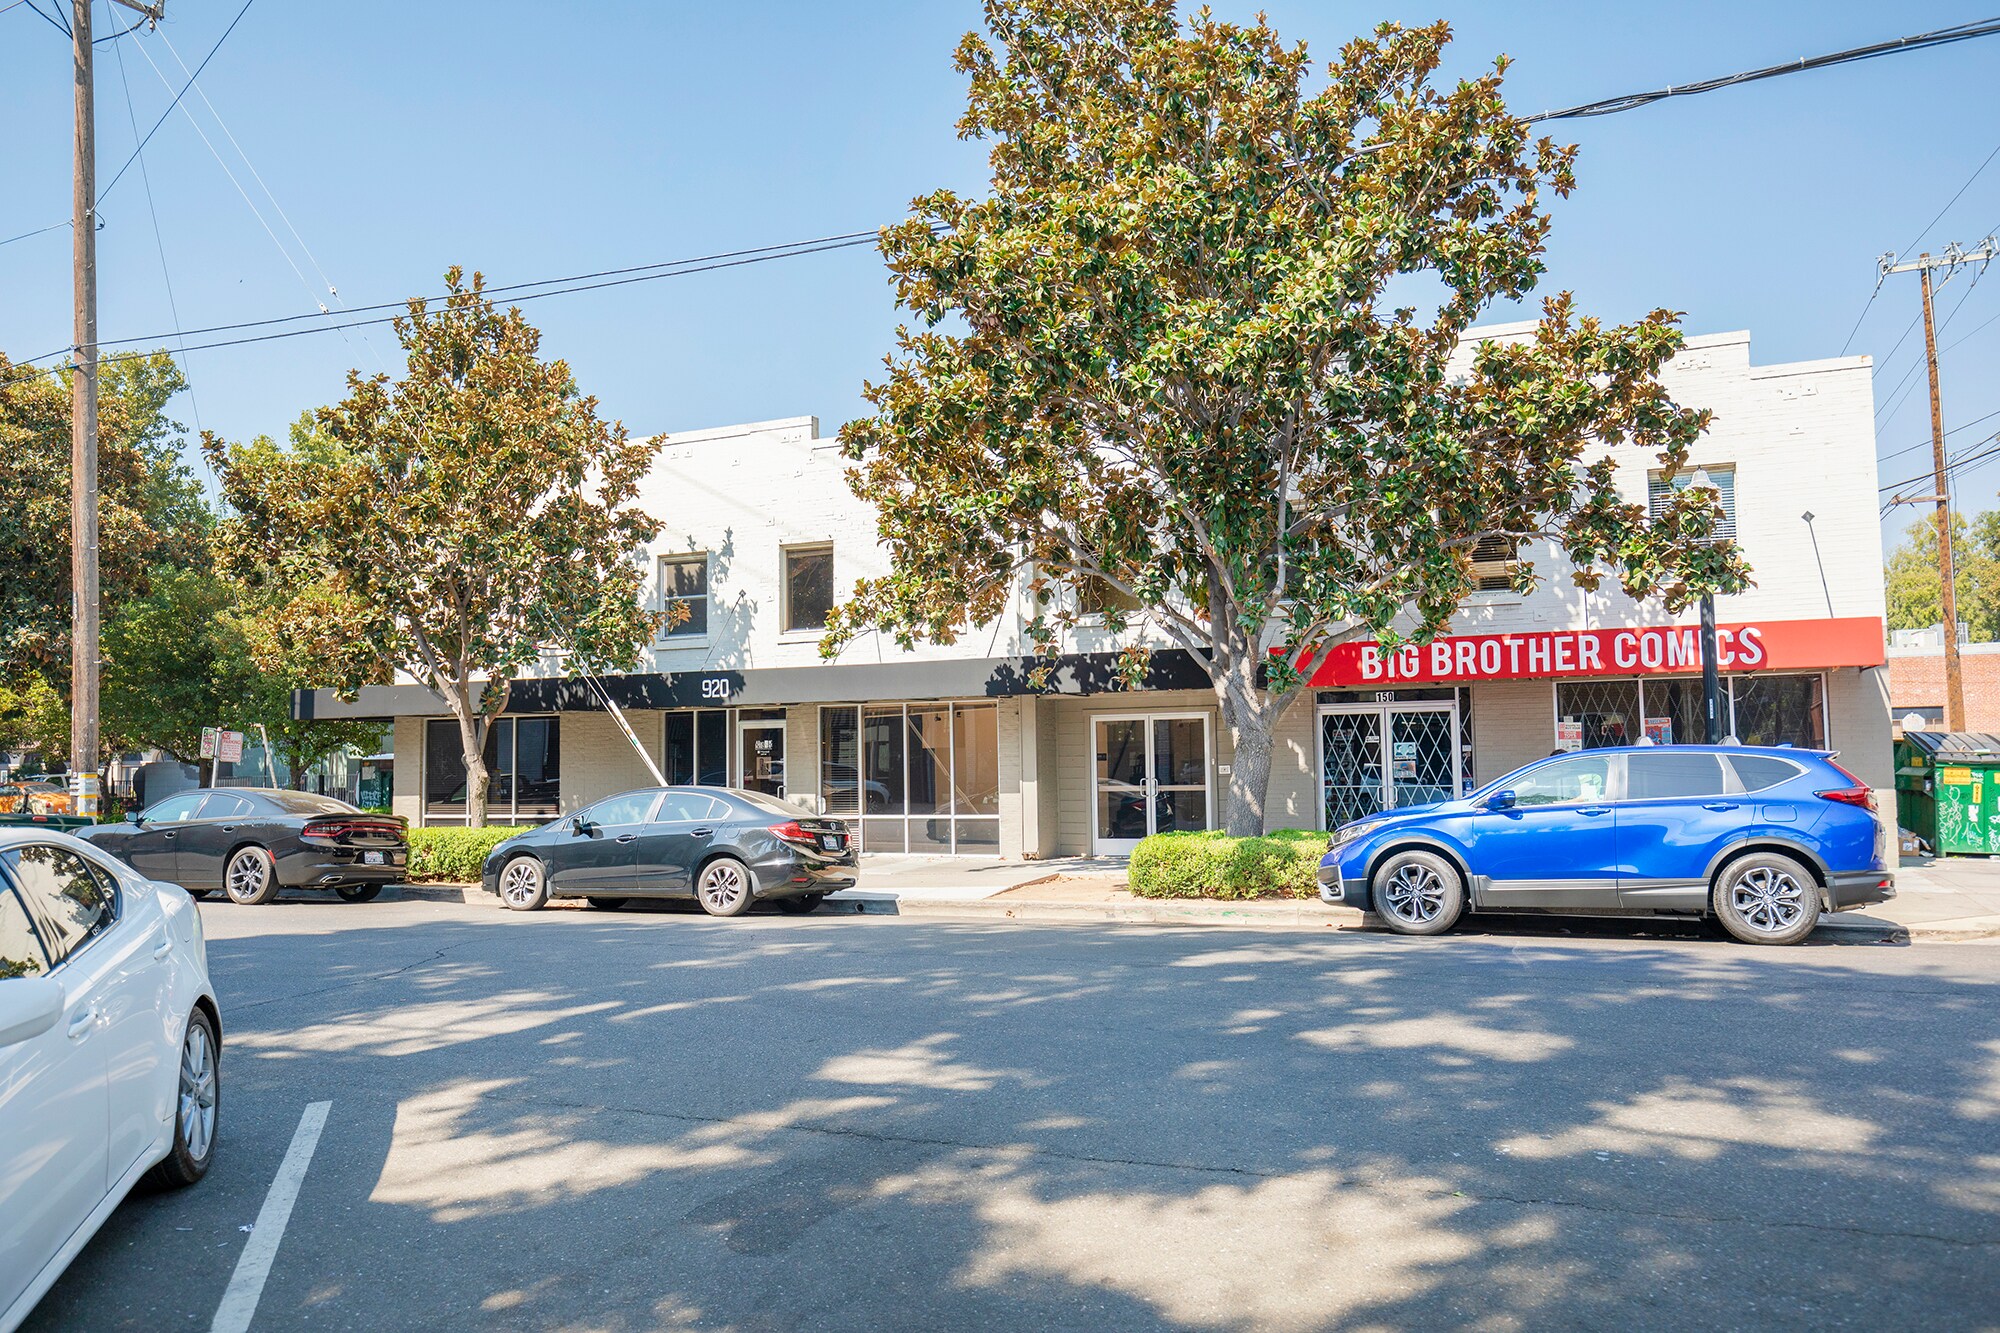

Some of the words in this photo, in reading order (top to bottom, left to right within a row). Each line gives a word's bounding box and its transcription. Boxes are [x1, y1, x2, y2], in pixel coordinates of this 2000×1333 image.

[1361, 644, 1420, 680] BIG
[1431, 634, 1602, 676] BROTHER
[1614, 627, 1763, 668] COMICS
[702, 678, 729, 698] 920
[1377, 692, 1393, 702] 150
